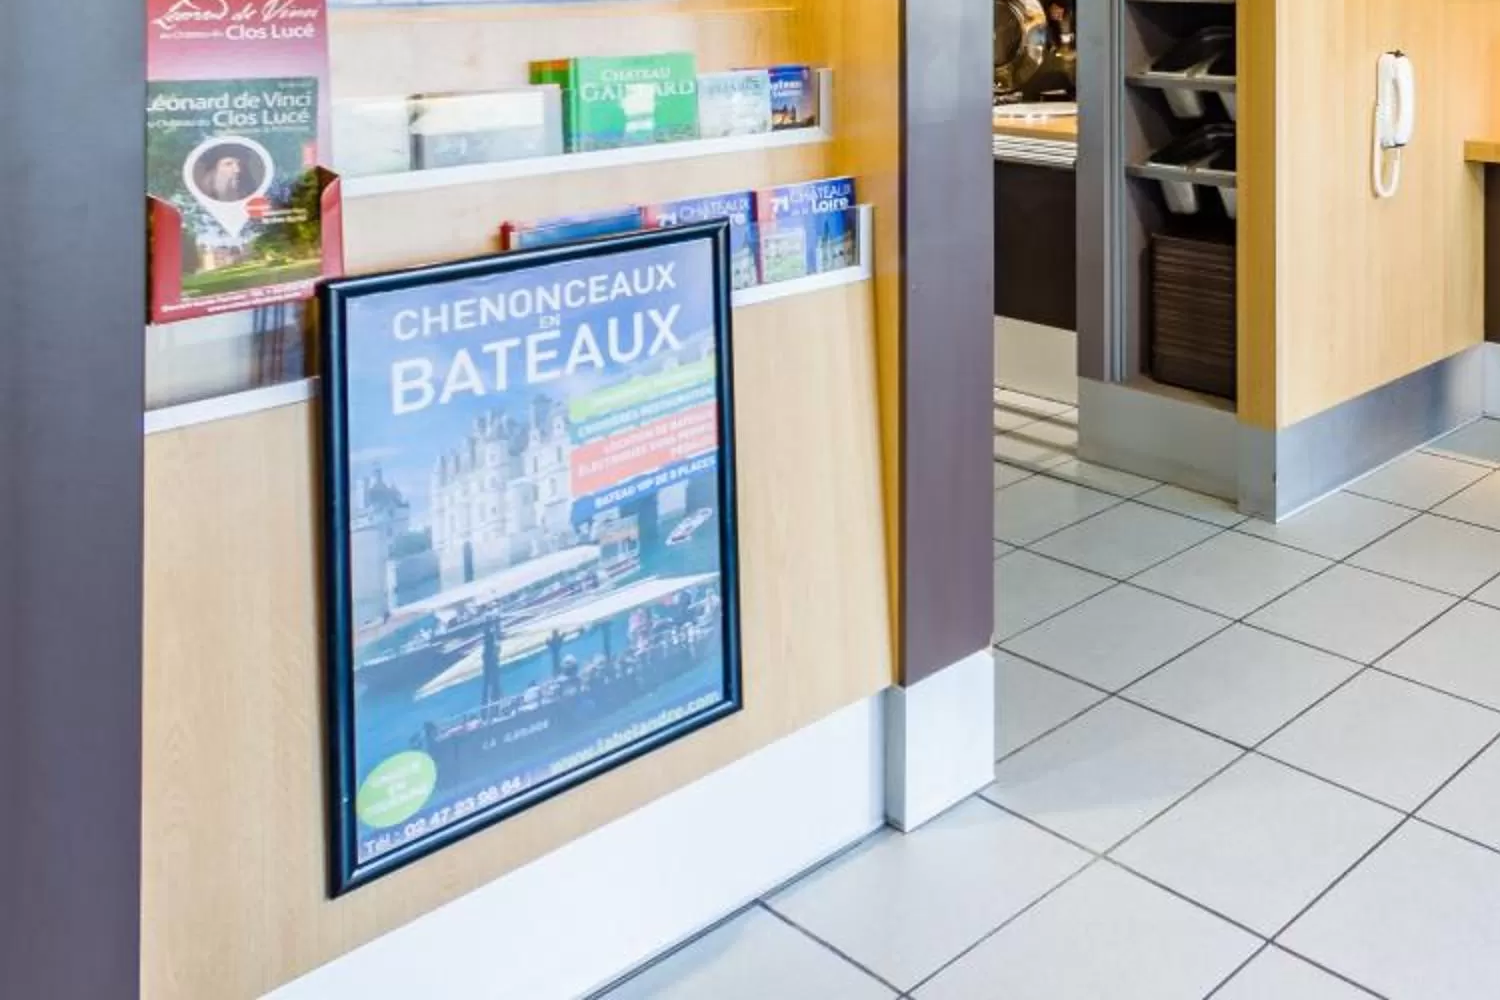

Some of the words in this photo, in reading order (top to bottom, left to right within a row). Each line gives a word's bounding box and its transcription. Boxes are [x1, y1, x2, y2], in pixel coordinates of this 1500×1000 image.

[225, 23, 267, 41] Clos
[271, 22, 316, 39] Lucé
[260, 90, 312, 108] Vinci
[212, 110, 257, 128] Clos
[262, 108, 311, 126] Lucé
[392, 261, 677, 341] CHENONCEAUX
[390, 303, 685, 417] BATEAUX
